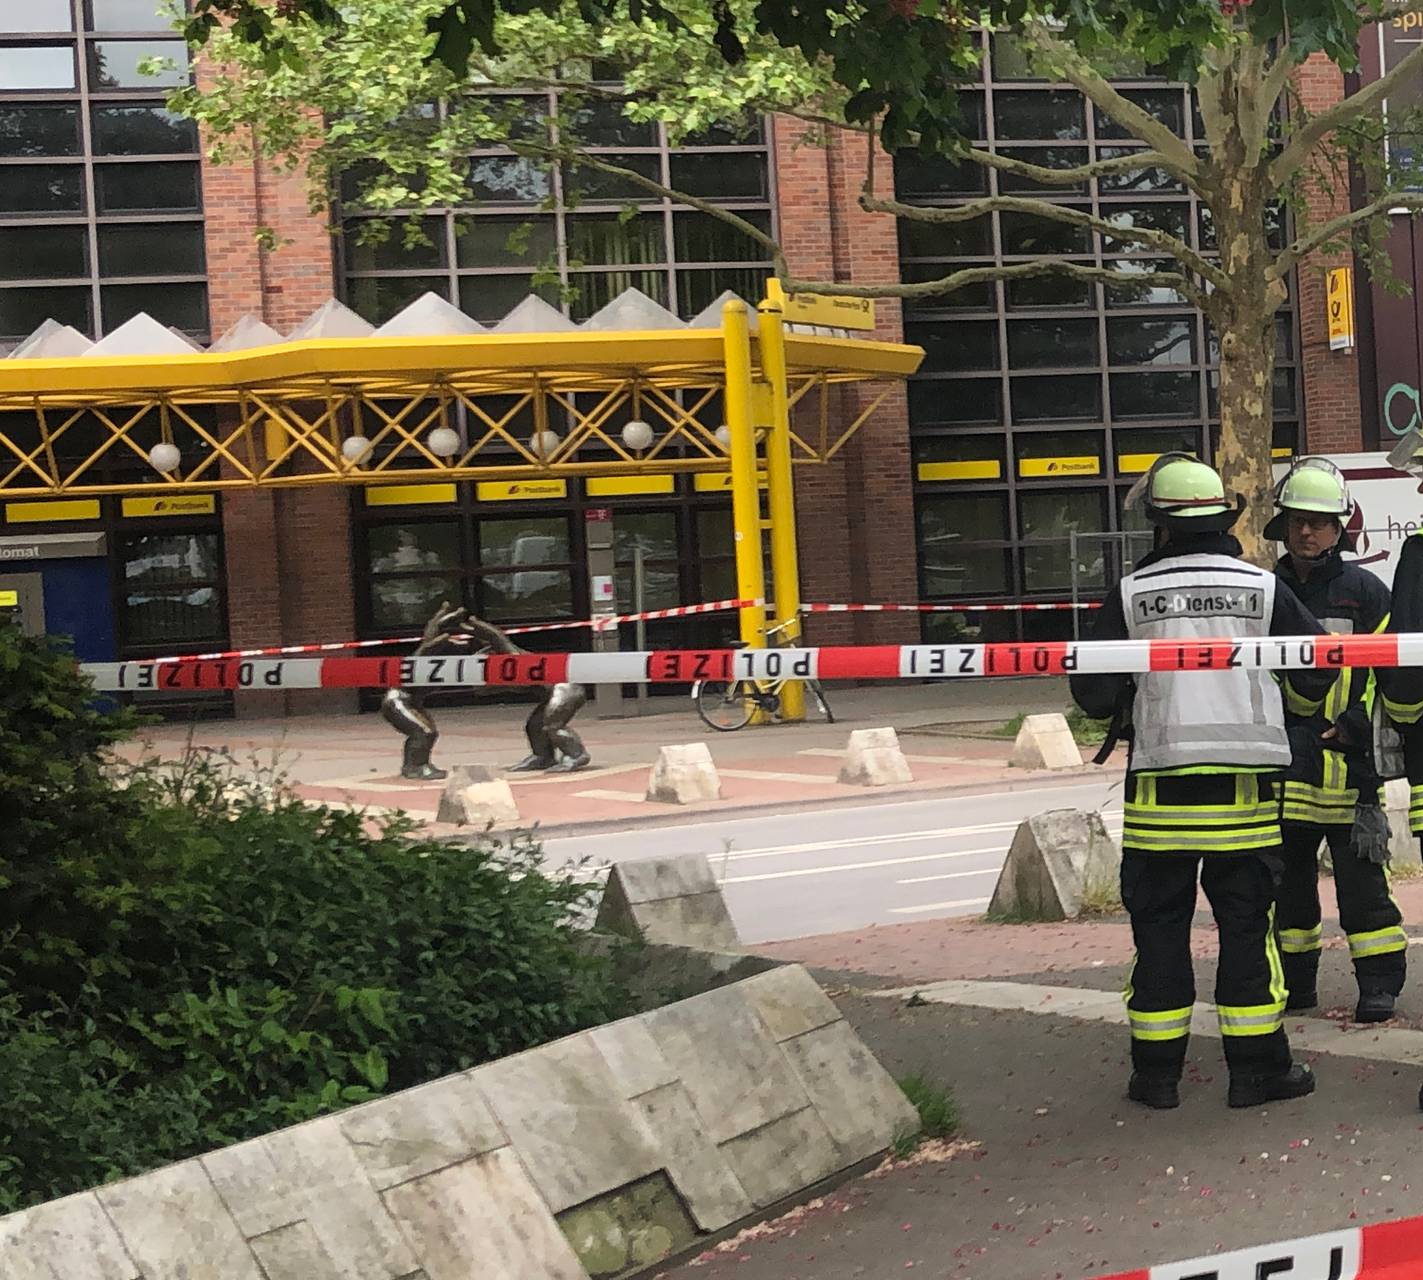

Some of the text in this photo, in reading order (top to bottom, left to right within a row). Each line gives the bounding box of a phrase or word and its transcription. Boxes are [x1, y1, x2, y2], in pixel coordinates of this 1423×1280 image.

[0, 546, 40, 558] omat
[646, 652, 811, 679] POLIZEI
[911, 646, 1078, 674] POLIZEI
[1176, 641, 1345, 668] POLIZEI
[119, 661, 283, 688] POLIZEI
[379, 655, 546, 684] POLIZEI
